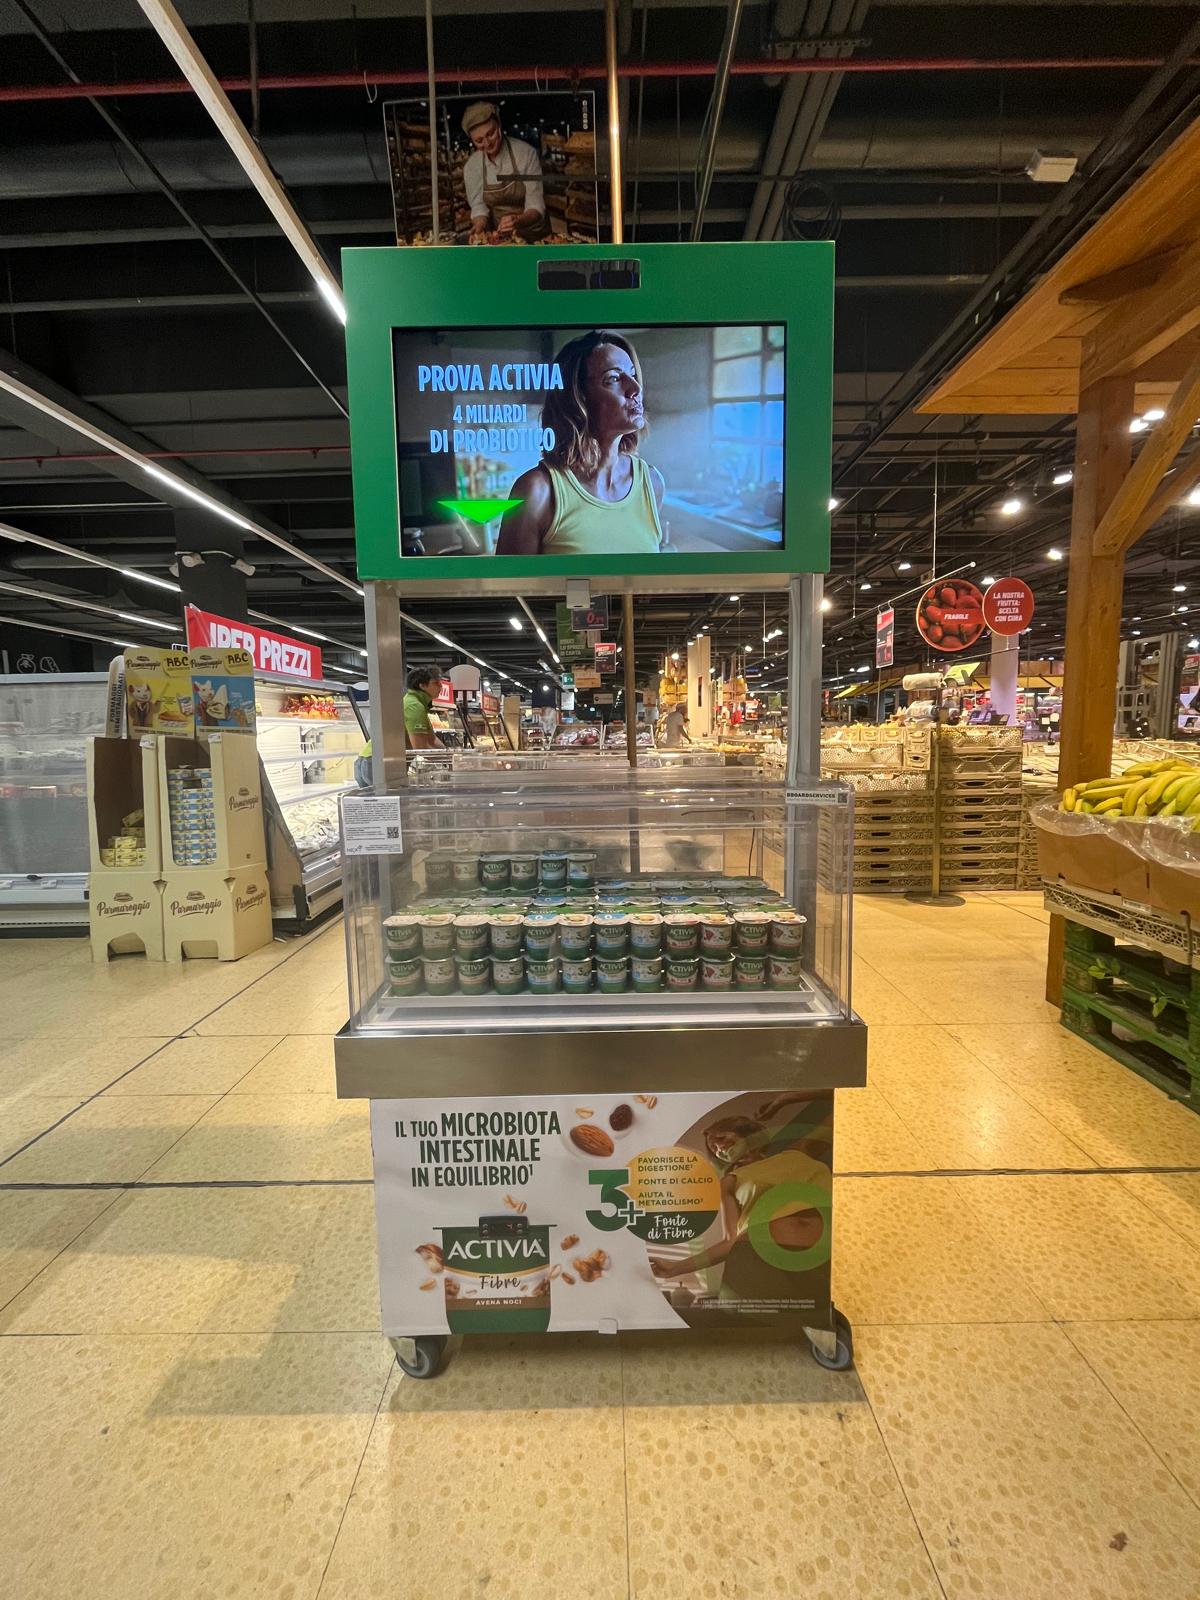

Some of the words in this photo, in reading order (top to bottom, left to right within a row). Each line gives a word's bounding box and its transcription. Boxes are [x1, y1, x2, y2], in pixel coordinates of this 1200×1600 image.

[418, 365, 484, 392] PROVA
[489, 363, 564, 391] ACTIVIA
[453, 405, 463, 424] 4
[466, 404, 527, 424] MILIARDI
[430, 429, 449, 453] DI
[453, 427, 556, 454] PROBIOTICO
[260, 636, 312, 678] PREZZI
[97, 899, 150, 917] Parmareggio
[170, 898, 222, 917] Parmareggio
[395, 1121, 407, 1138] IL
[411, 1121, 438, 1138] TUO
[441, 1111, 562, 1137] MICROBIOTA
[420, 1138, 541, 1164] INTESTINALE
[411, 1167, 429, 1187] IN
[653, 1214, 689, 1228] Fonte
[647, 1227, 661, 1240] di
[663, 1227, 696, 1240] Fibre
[447, 1238, 547, 1260] ACTIVIA
[480, 1275, 521, 1290] Fibre
